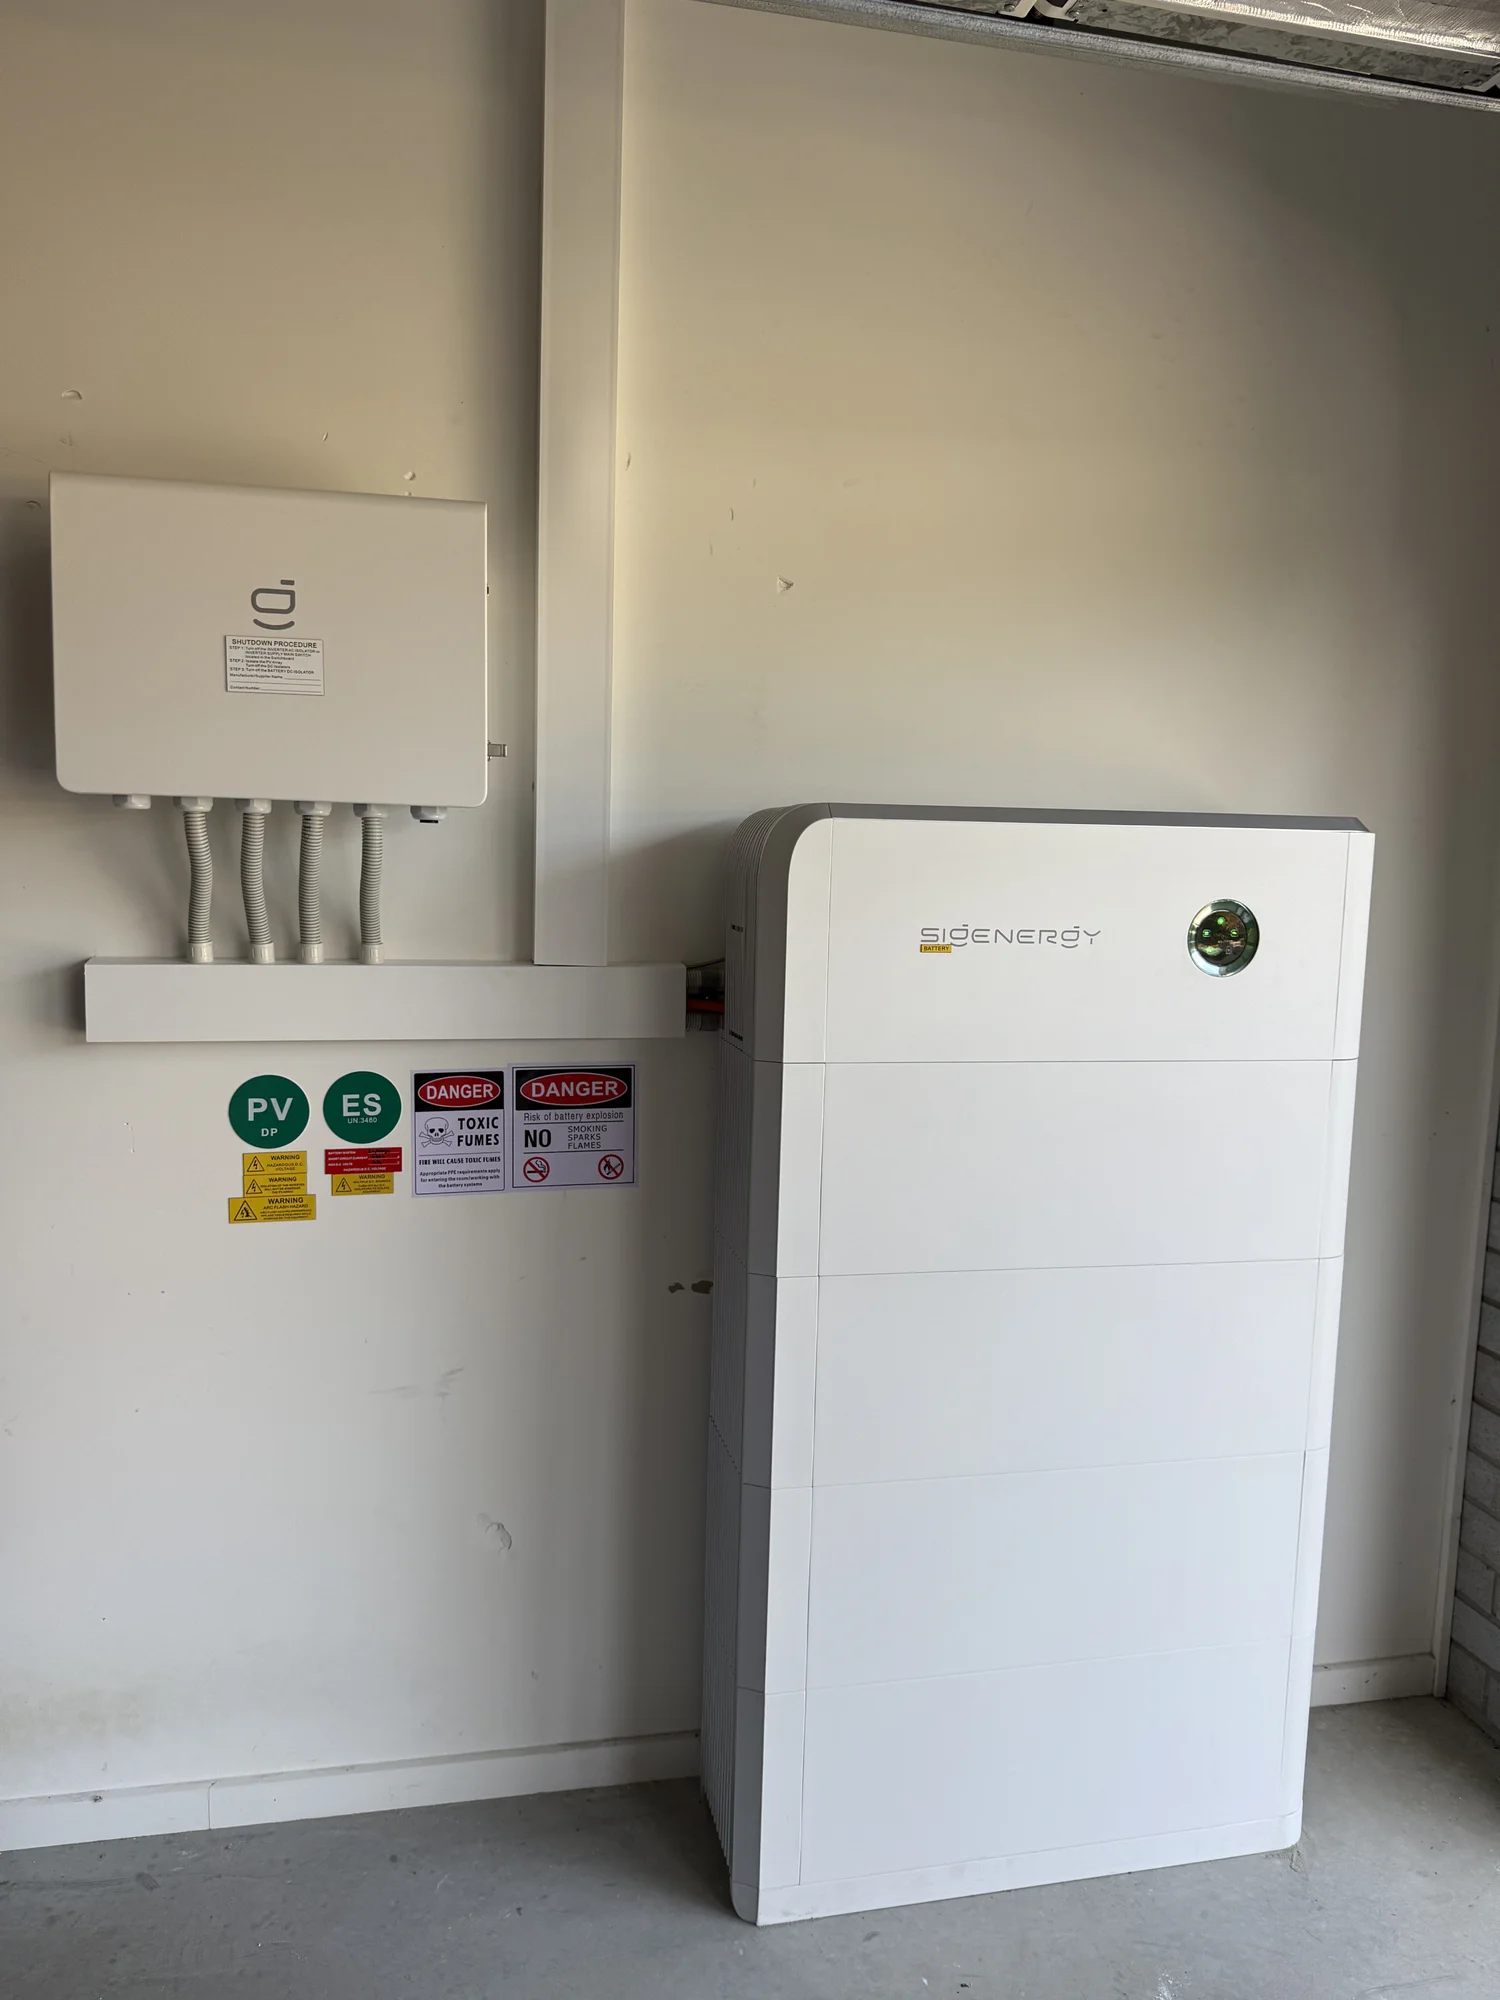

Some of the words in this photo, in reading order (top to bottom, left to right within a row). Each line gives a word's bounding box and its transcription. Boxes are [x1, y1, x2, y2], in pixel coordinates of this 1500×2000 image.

[426, 1084, 494, 1100] DANGER
[531, 1081, 619, 1097] DANGER
[248, 1097, 293, 1121] PV
[343, 1093, 382, 1116] ES
[524, 1113, 540, 1121] Risk
[544, 1112, 552, 1121] of
[555, 1112, 583, 1122] battery
[586, 1111, 624, 1120] explosion
[458, 1117, 499, 1130] TOXIC
[568, 1125, 607, 1133] SMOKING
[261, 1128, 278, 1136] DP
[524, 1129, 552, 1148] NO
[568, 1133, 601, 1141] SPARKS
[458, 1134, 499, 1147] FUMES
